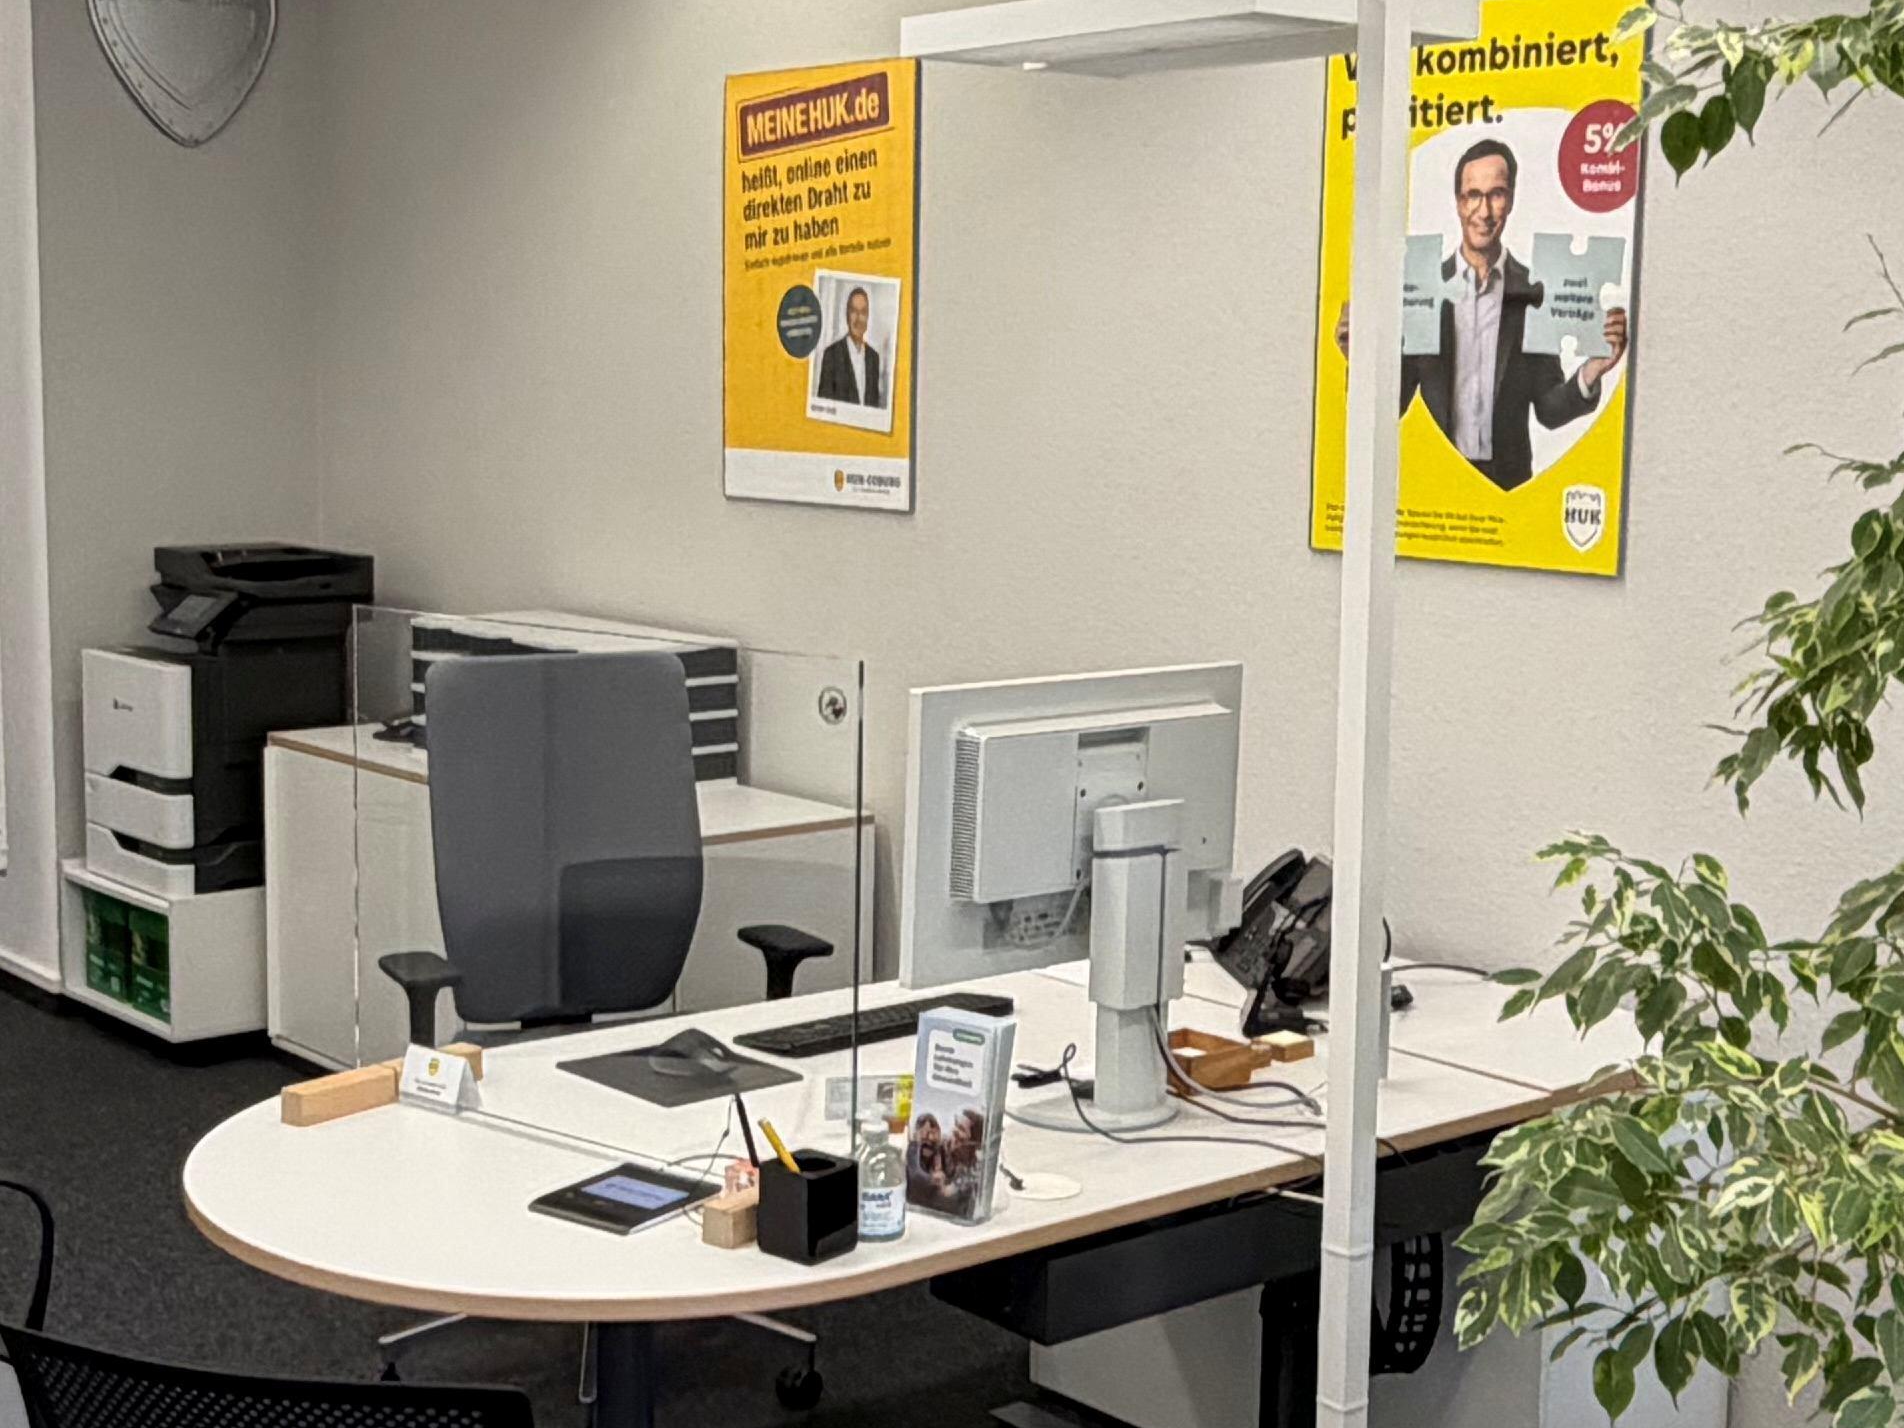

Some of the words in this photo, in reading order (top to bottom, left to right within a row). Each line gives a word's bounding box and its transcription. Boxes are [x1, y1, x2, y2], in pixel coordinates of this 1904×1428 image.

[1416, 31, 1620, 77] kombiniert,
[746, 87, 880, 148] MEINEHUK.de
[1342, 92, 1504, 141] pitiert.
[742, 164, 783, 194] heißt,
[786, 155, 831, 186] online
[835, 148, 878, 173] einen
[743, 192, 803, 222] direkten
[807, 180, 849, 210] Draht
[853, 180, 872, 201] zu
[745, 225, 768, 253] mir
[772, 228, 790, 246] zu
[793, 215, 840, 242] haben
[1564, 507, 1602, 525] HUK
